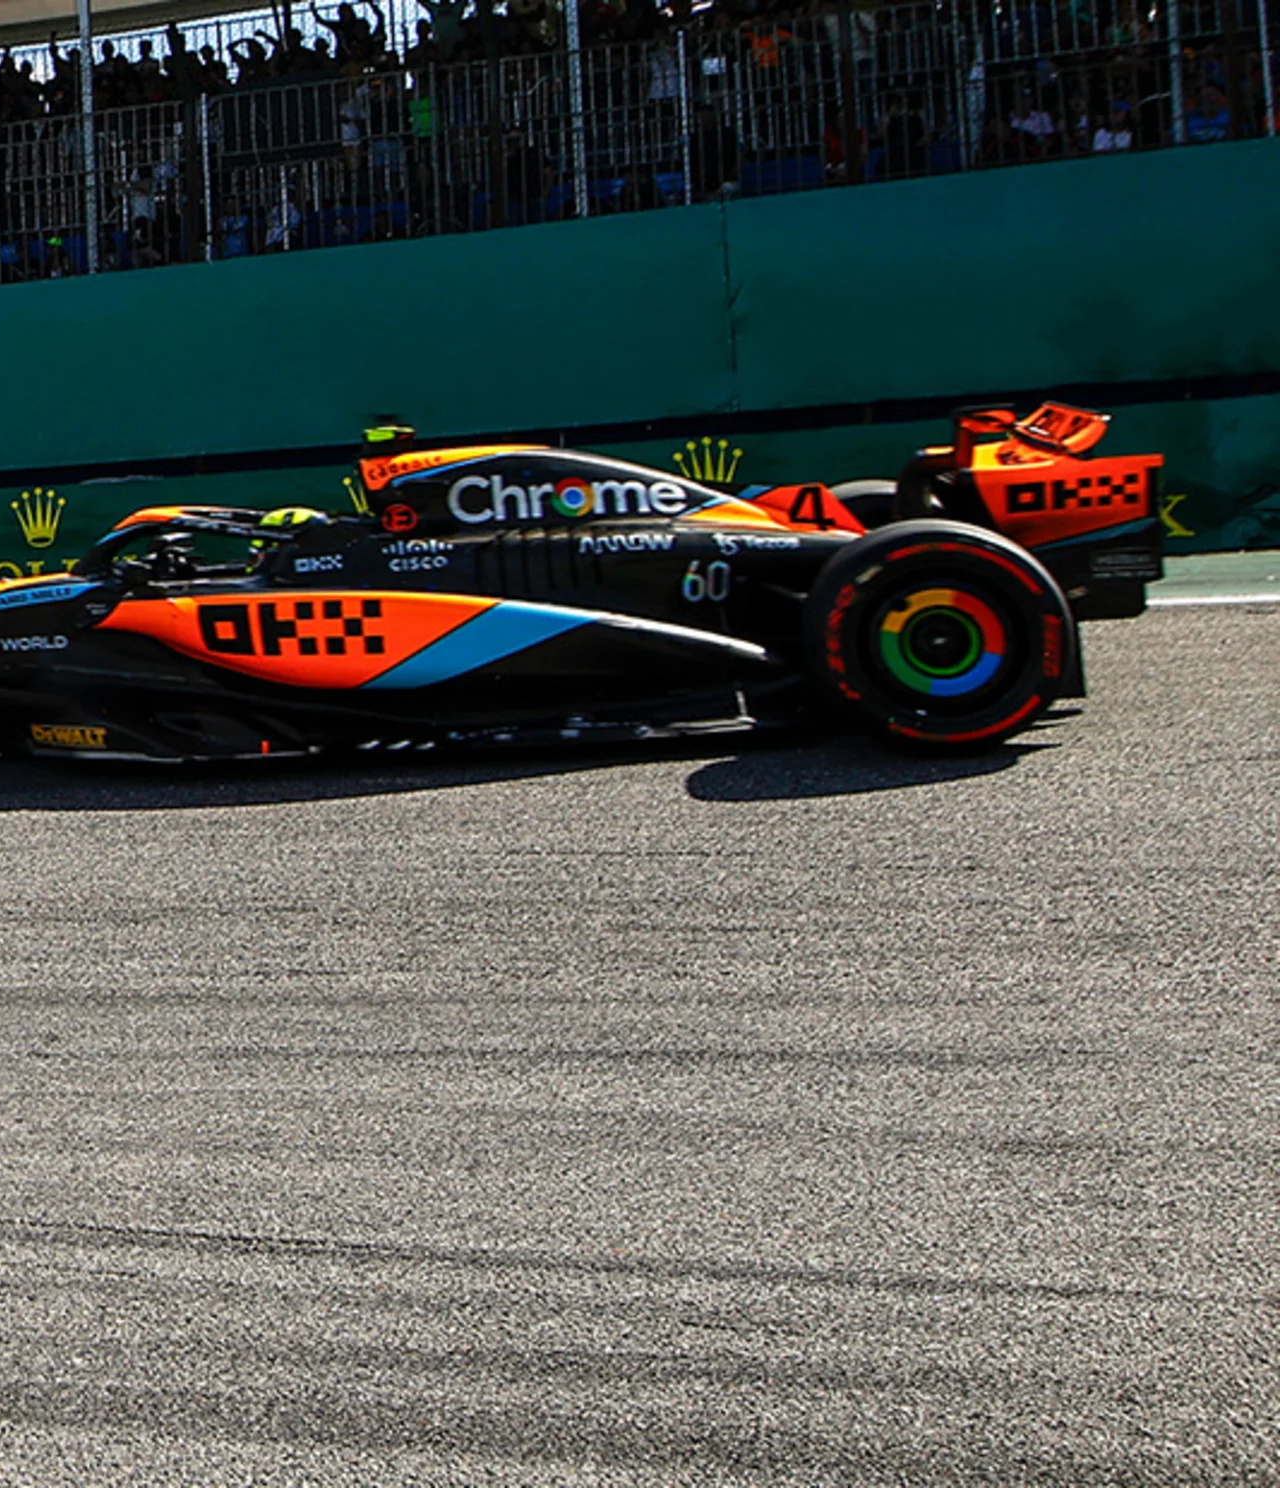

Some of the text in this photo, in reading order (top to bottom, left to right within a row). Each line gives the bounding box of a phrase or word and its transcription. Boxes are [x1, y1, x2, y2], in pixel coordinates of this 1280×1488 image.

[447, 473, 688, 527] Chrome
[790, 486, 837, 532] 4
[1006, 474, 1139, 514] OKX
[388, 556, 449, 572] CISCO
[681, 560, 731, 602] 60
[0, 635, 69, 652] WORLD
[197, 599, 386, 657] OKX
